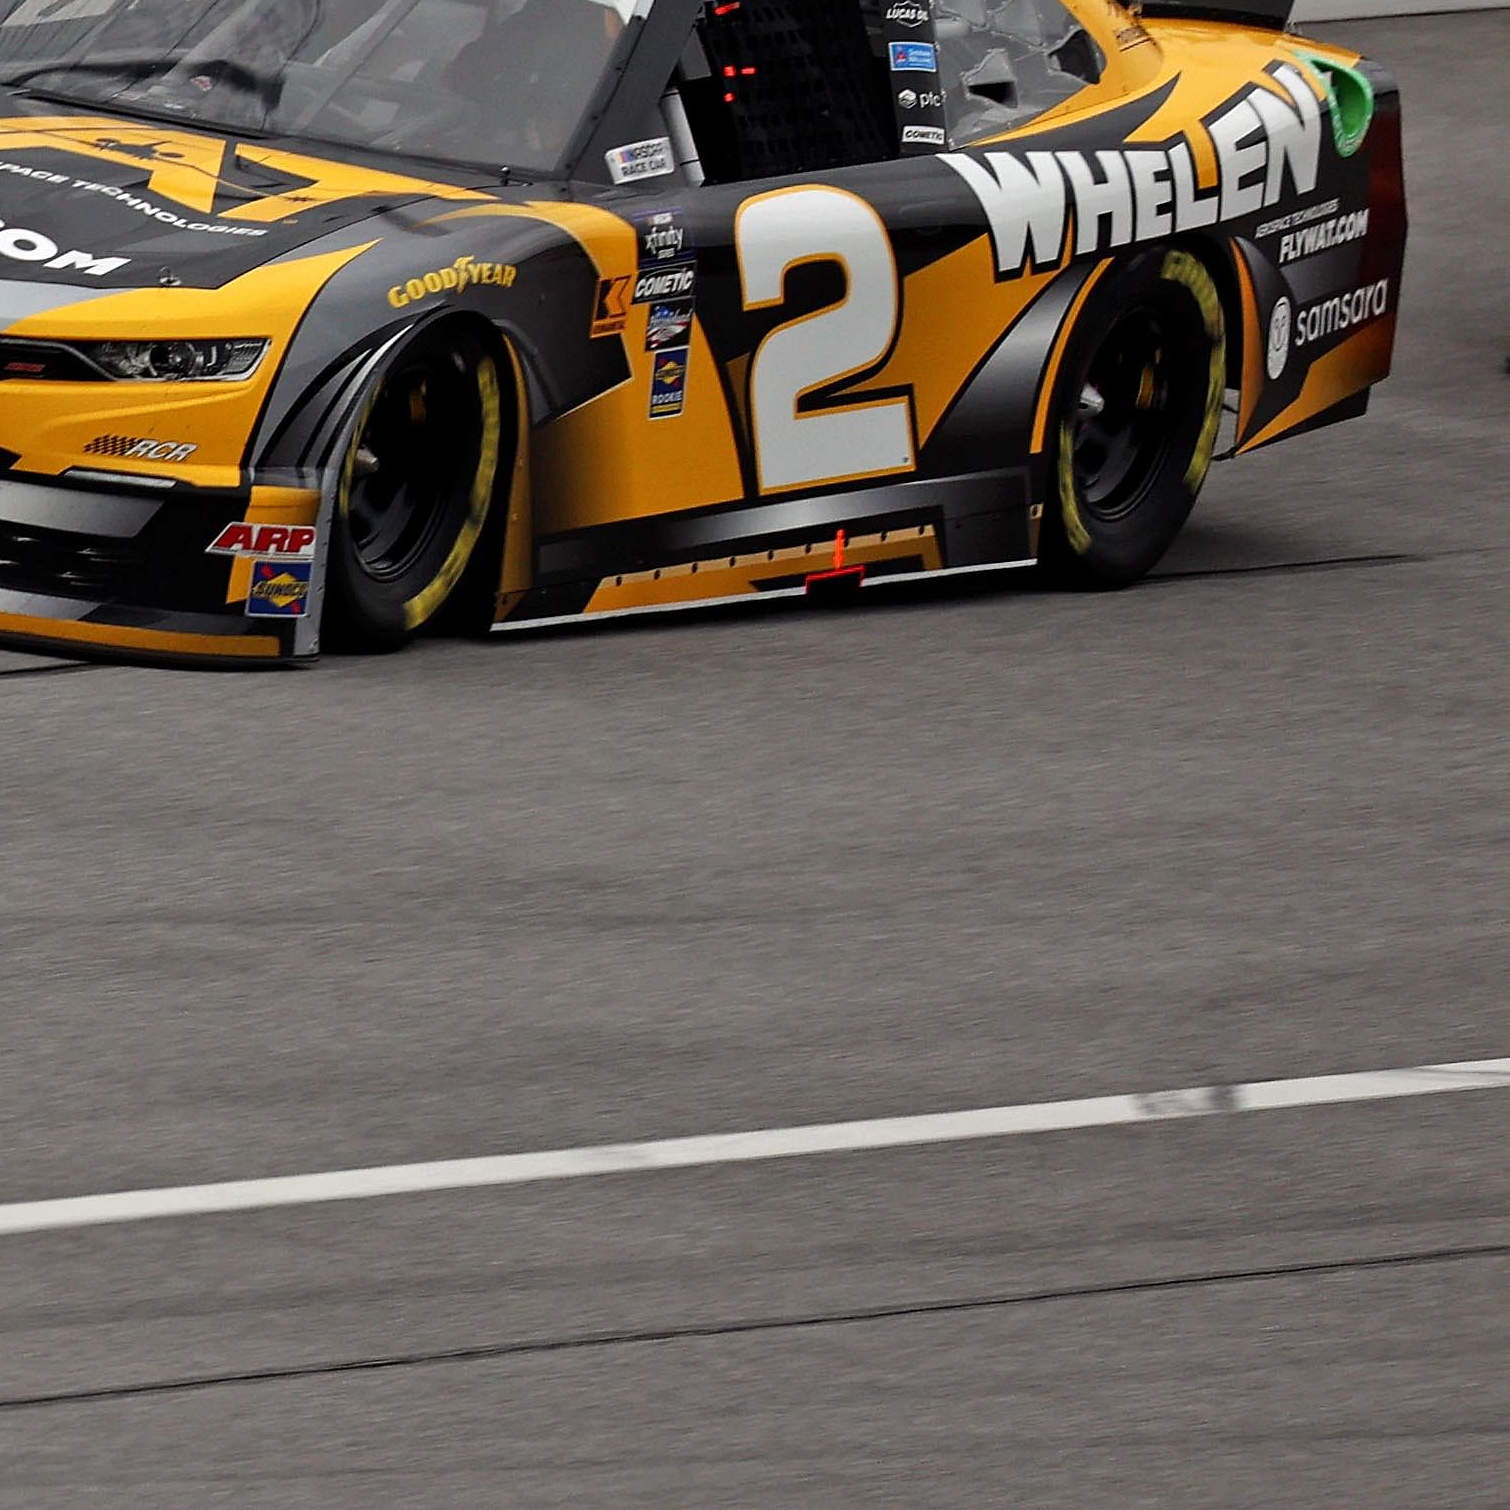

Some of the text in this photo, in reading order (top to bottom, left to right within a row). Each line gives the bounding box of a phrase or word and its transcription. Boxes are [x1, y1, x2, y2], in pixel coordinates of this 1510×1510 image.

[886, 8, 916, 19] LUCAS
[935, 63, 1322, 273] WHELEN
[72, 178, 270, 237] TECHNOLOGIES
[1279, 207, 1370, 265] FLYWAT.COM
[387, 256, 517, 308] GOODYEAR
[634, 270, 695, 299] COMETIC
[734, 184, 918, 496] 2
[1294, 278, 1389, 347] samsara
[126, 439, 199, 461] RCR
[211, 524, 317, 553] ARP
